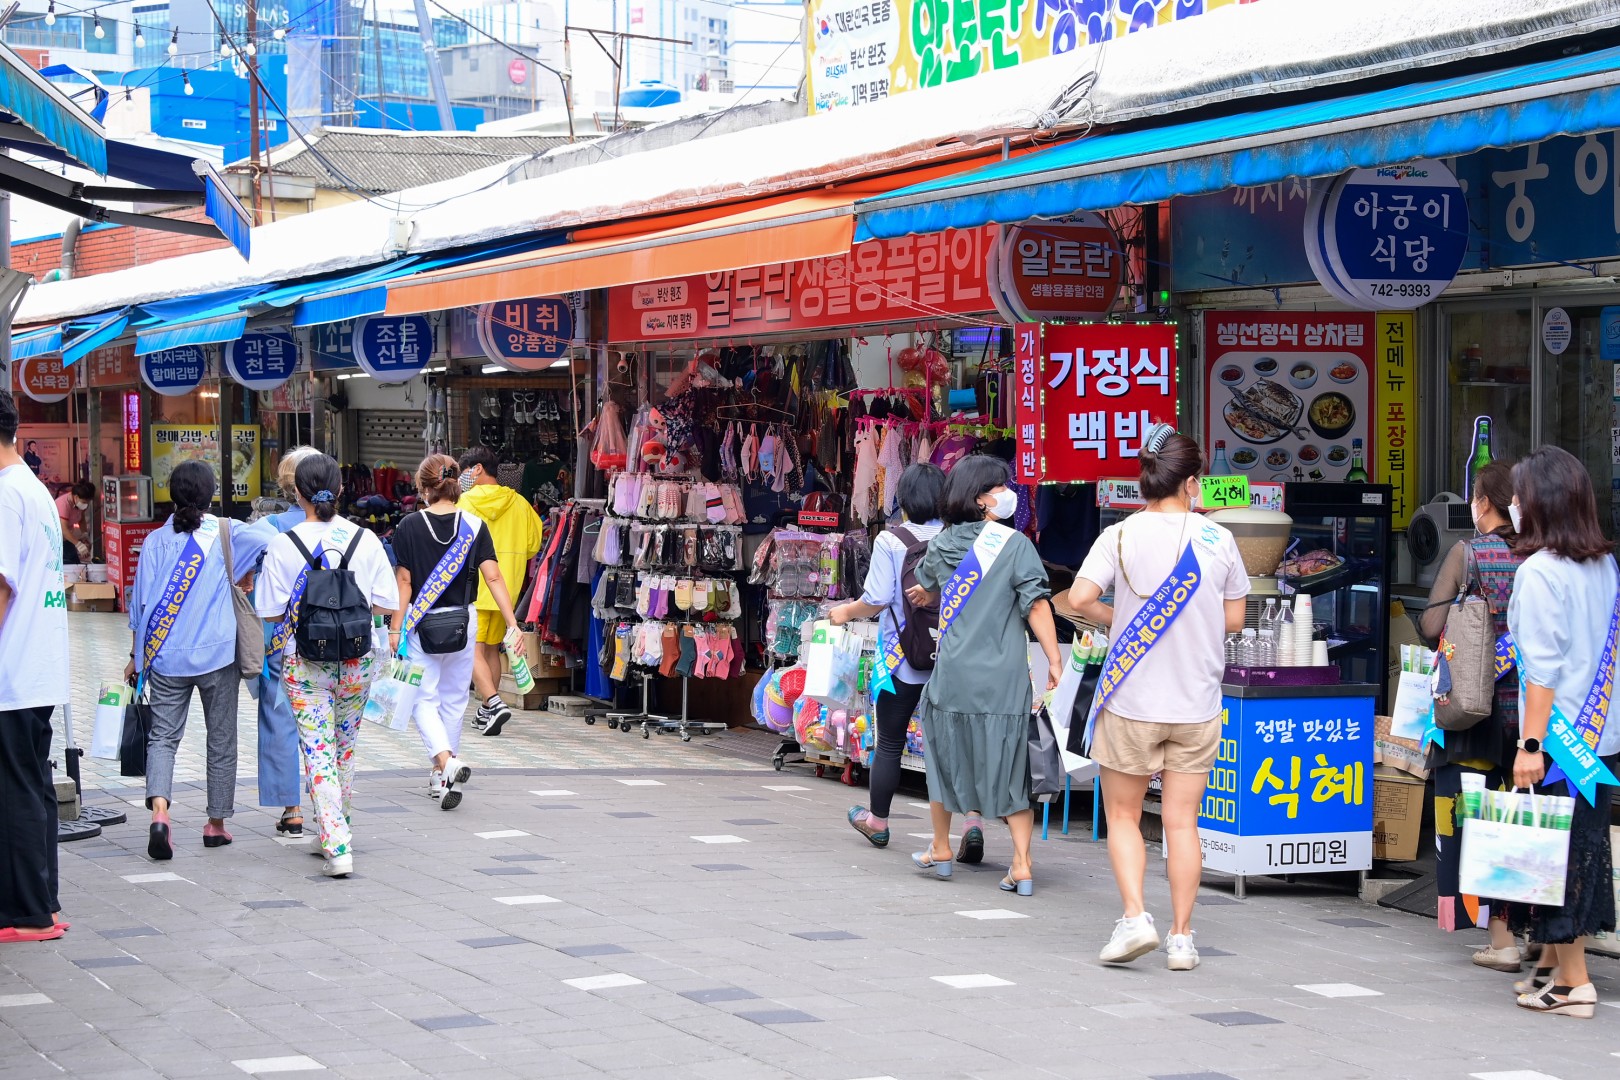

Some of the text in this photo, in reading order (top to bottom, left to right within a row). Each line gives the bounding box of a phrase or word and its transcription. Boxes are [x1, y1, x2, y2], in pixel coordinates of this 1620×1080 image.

[235, 4, 278, 22] SHLLA
[835, 0, 891, 33] 대한민국 토종
[850, 42, 887, 70] 부산 원조
[851, 78, 889, 107] 지역 밀착
[1354, 191, 1450, 231] 아궁이
[1018, 239, 1113, 278] 알토란
[1370, 235, 1436, 273] 식당
[657, 287, 669, 303] 부산
[670, 285, 682, 300] 원조
[1030, 282, 1105, 299] 생활용품할인점
[1370, 283, 1431, 298] 742-9393
[505, 303, 560, 332] 비취
[667, 314, 679, 330] 지역
[680, 312, 692, 329] 밀착
[376, 322, 419, 343] 조은
[507, 333, 558, 353] 양품점
[1216, 322, 1365, 347] 생선정식 상차림
[150, 346, 199, 364] 돼지국밥
[244, 338, 285, 357] 과일
[376, 344, 420, 365] 신발
[37, 361, 62, 374] 중앙
[151, 364, 200, 382] 할매김밥
[245, 356, 286, 375] 천국
[1048, 346, 1171, 398] 가정식
[30, 375, 70, 389] 식육점
[1020, 330, 1036, 478] 가정식 백반
[1385, 321, 1406, 519] 전메뉴 포장됩니다
[1067, 409, 1156, 459] 백반
[1116, 484, 1139, 501] 전메뉴
[1212, 485, 1246, 507] 식혜
[1153, 575, 1180, 603] 엑스포
[1132, 602, 1157, 628] 유치를
[1254, 718, 1362, 744] 정말 맛있는
[1250, 753, 1364, 819] 식혜
[1265, 839, 1348, 868] 1.000원
